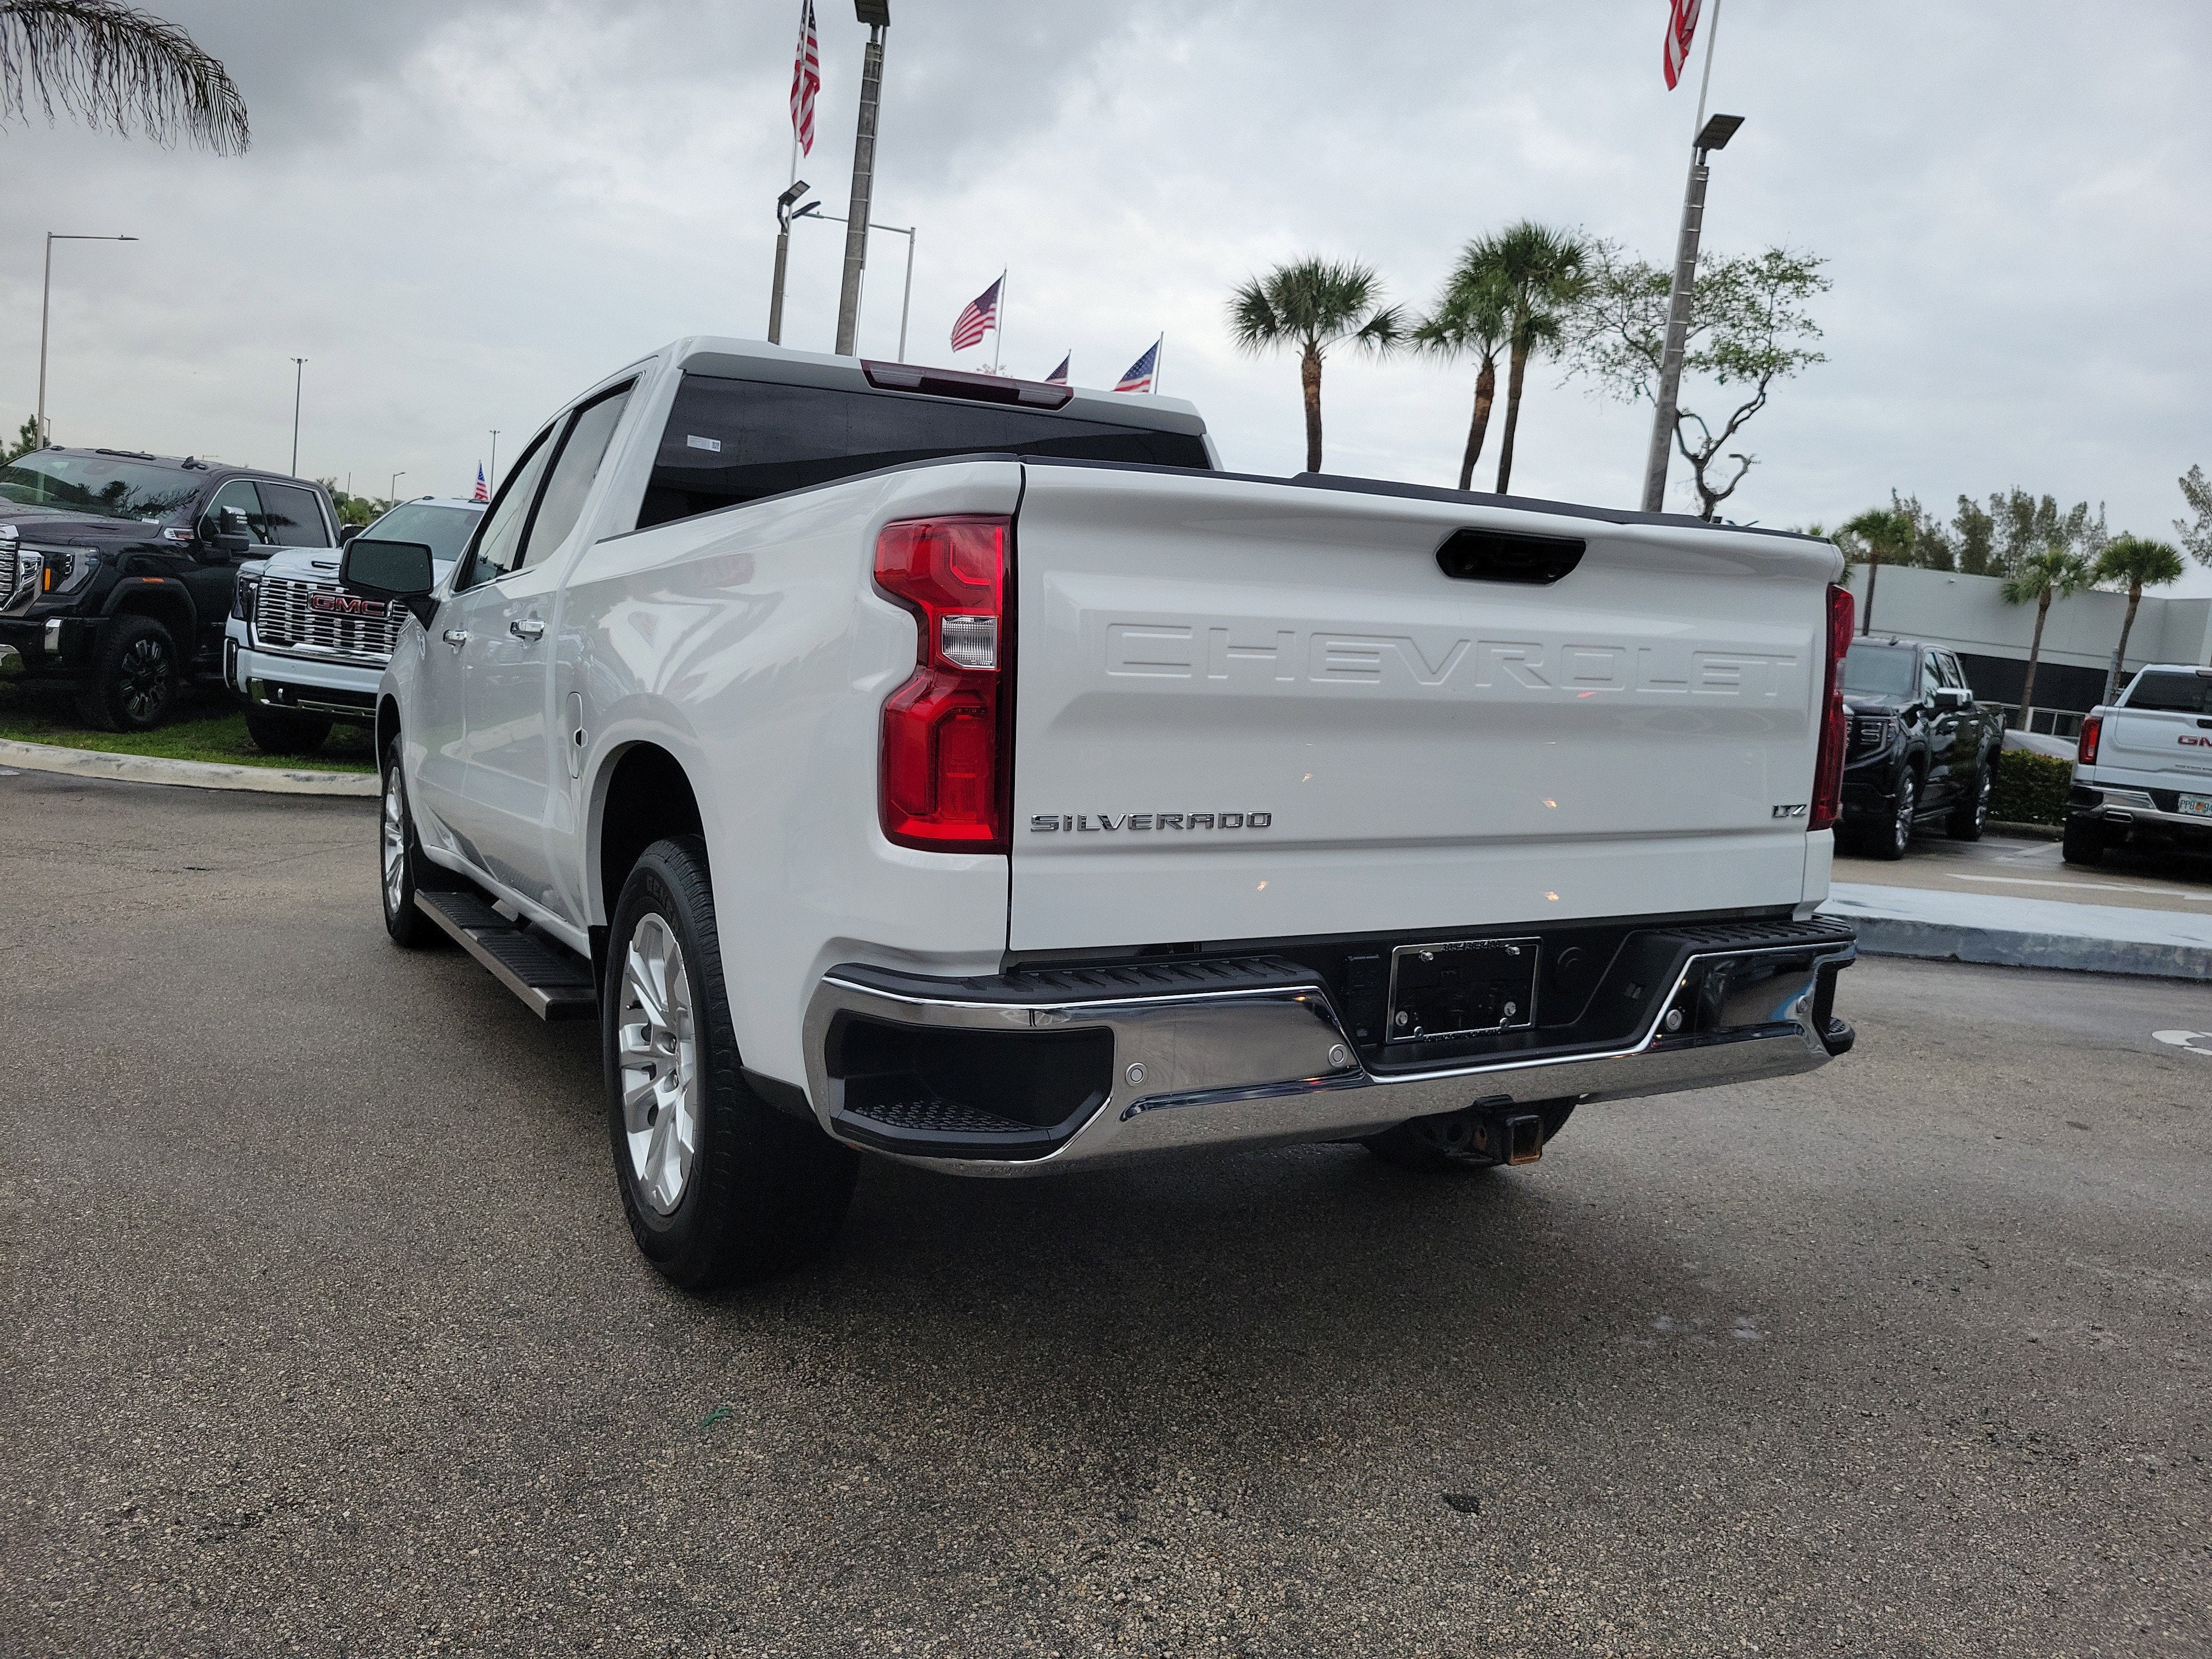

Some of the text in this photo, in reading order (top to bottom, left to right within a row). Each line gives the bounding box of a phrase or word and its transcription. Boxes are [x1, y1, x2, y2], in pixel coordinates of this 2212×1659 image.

[312, 594, 386, 616] GMC
[1105, 623, 1797, 696] CHEVROLET
[1030, 811, 1272, 832] SILVERADO
[1772, 804, 1807, 818] LTZ
